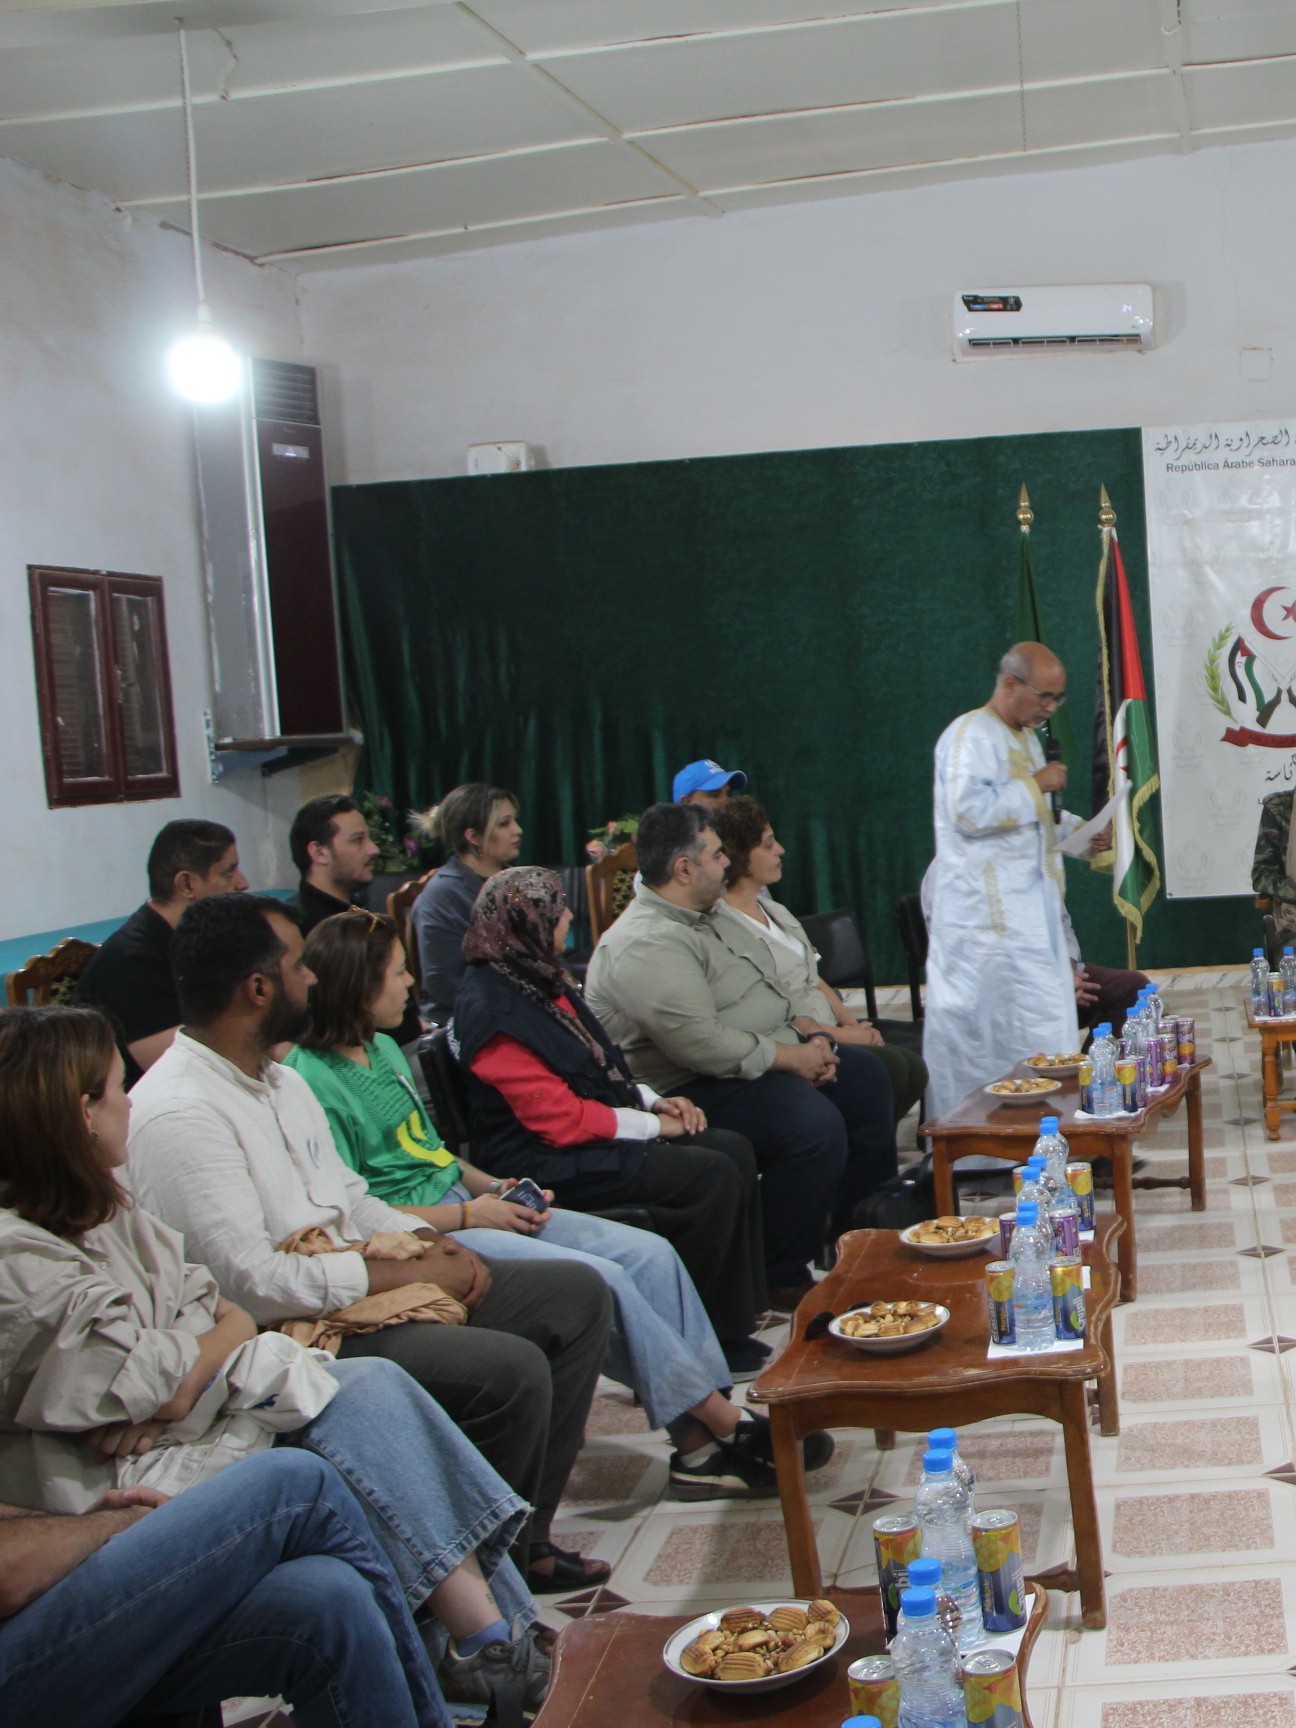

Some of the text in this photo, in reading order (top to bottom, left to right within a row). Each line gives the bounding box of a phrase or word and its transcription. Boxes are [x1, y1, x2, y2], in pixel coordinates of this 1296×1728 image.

[1154, 432, 1220, 461] الديمقراطية
[1223, 427, 1290, 457] الصحراوية
[1166, 460, 1220, 474] República
[1222, 457, 1255, 470] Árabe
